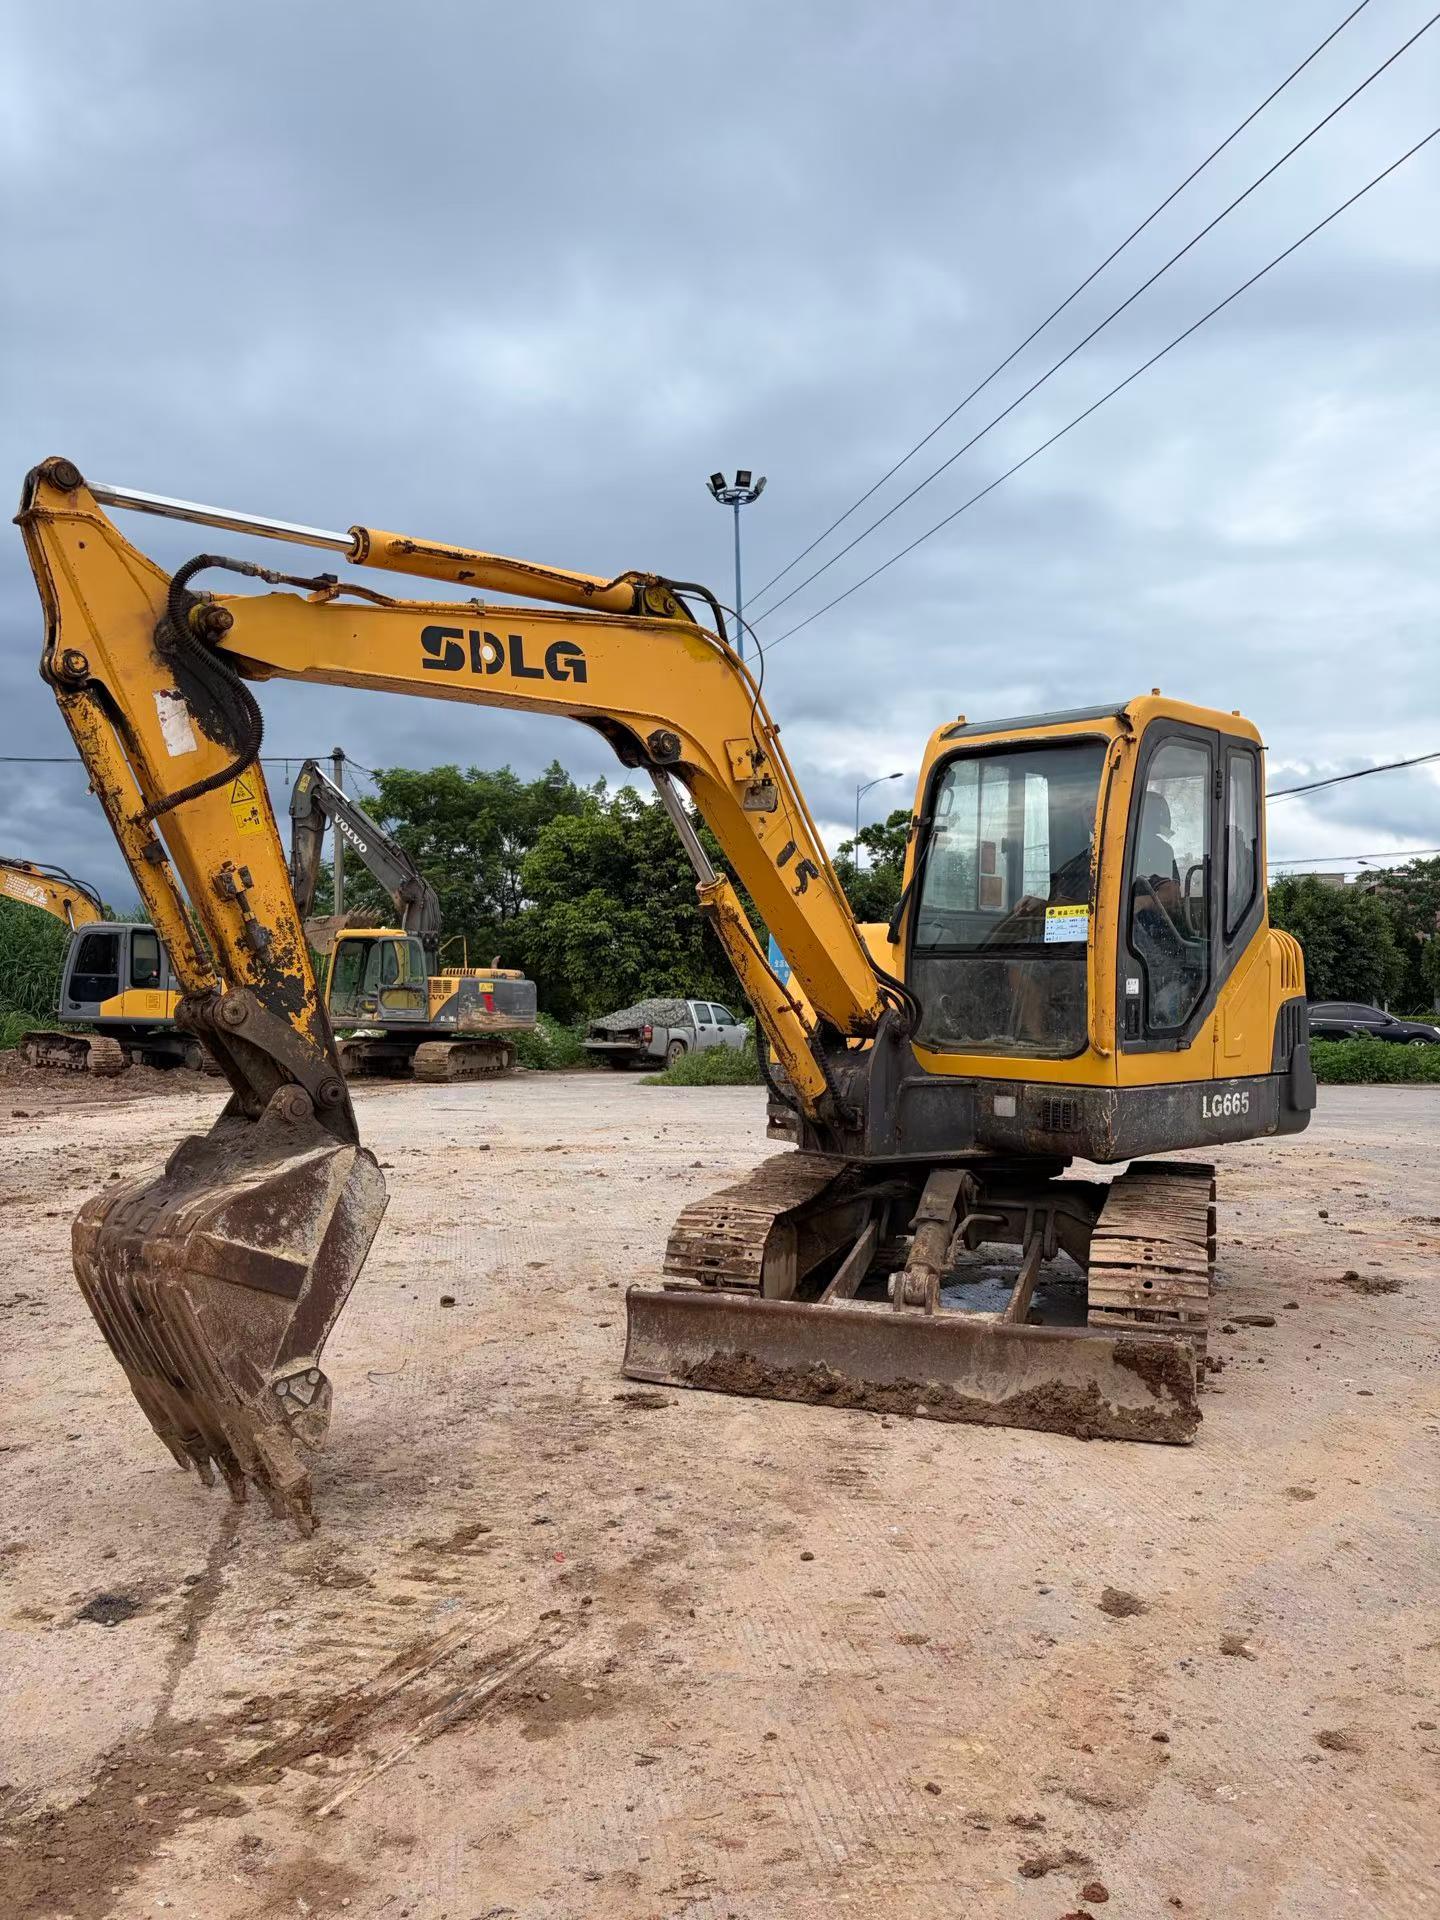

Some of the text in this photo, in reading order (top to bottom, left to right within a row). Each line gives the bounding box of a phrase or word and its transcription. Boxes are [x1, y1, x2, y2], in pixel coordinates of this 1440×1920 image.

[420, 625, 587, 684] SDLG
[334, 812, 368, 853] VOLVO
[1202, 1091, 1250, 1119] LG665
